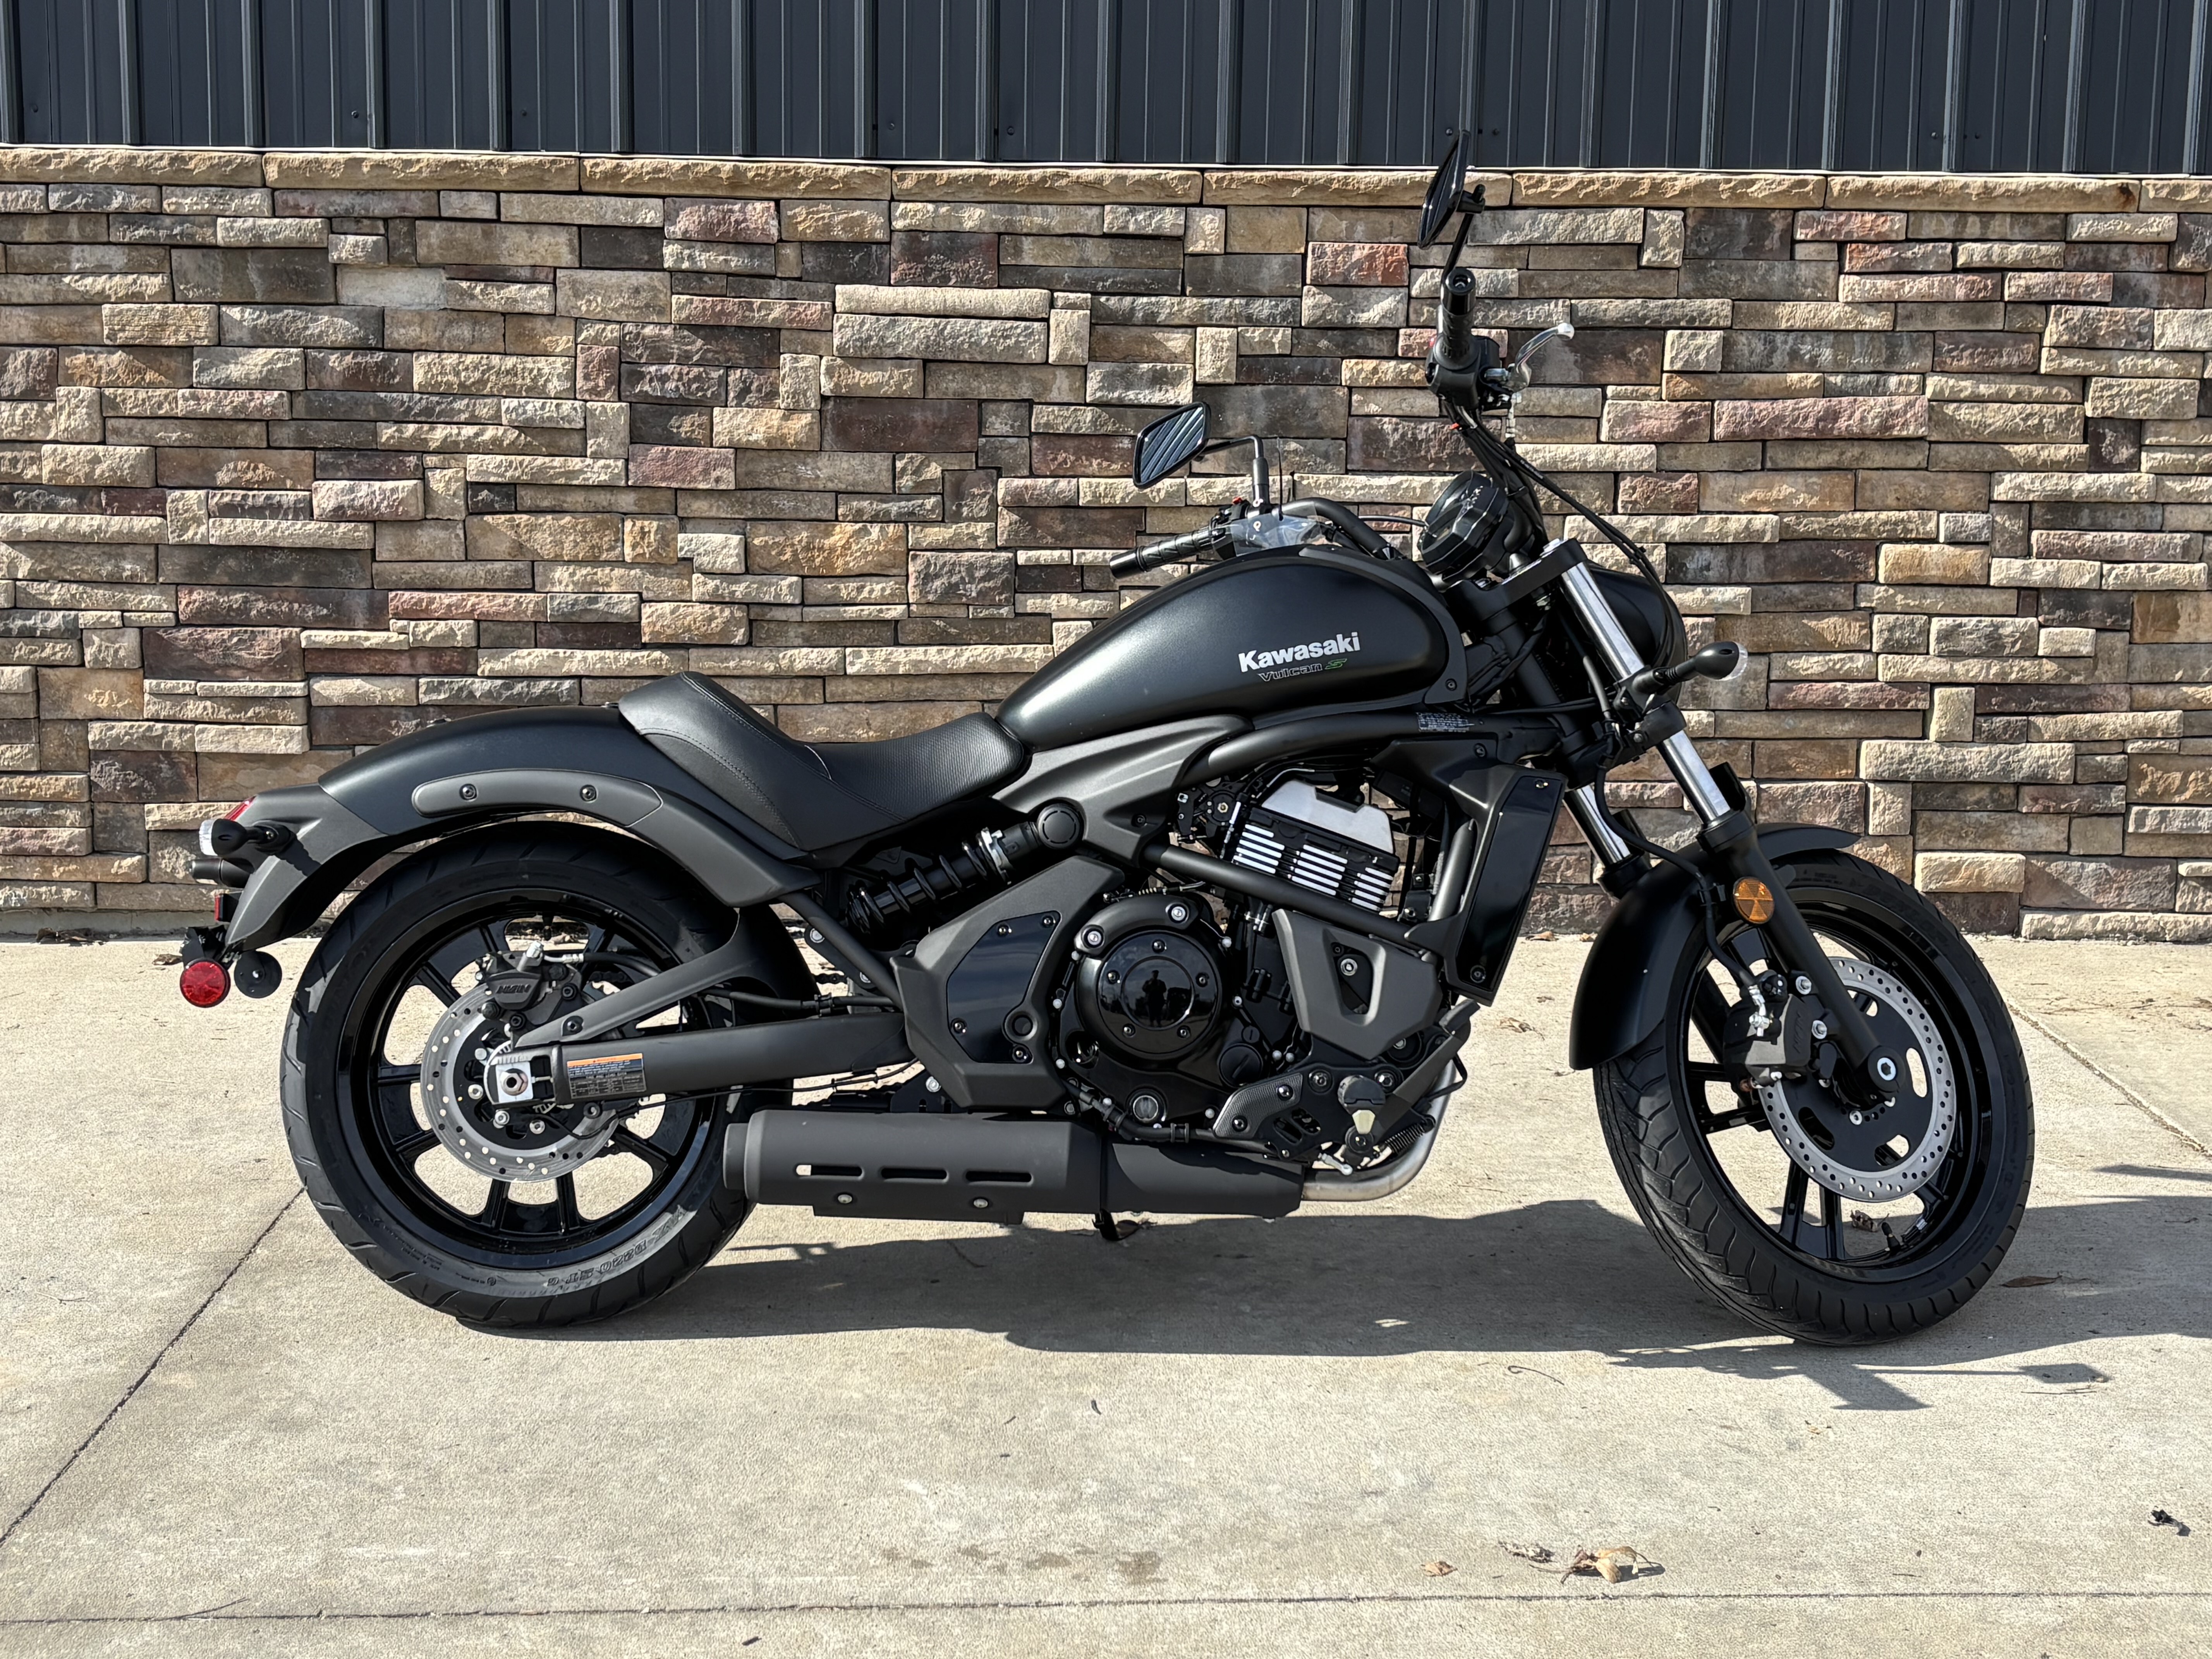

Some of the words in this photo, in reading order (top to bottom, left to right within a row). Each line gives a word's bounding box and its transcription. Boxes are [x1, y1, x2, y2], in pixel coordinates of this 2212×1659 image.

[1238, 632, 1360, 672] Kawasaki
[1257, 663, 1322, 682] Vulcan
[1325, 658, 1347, 670] S
[600, 1240, 646, 1274] D220
